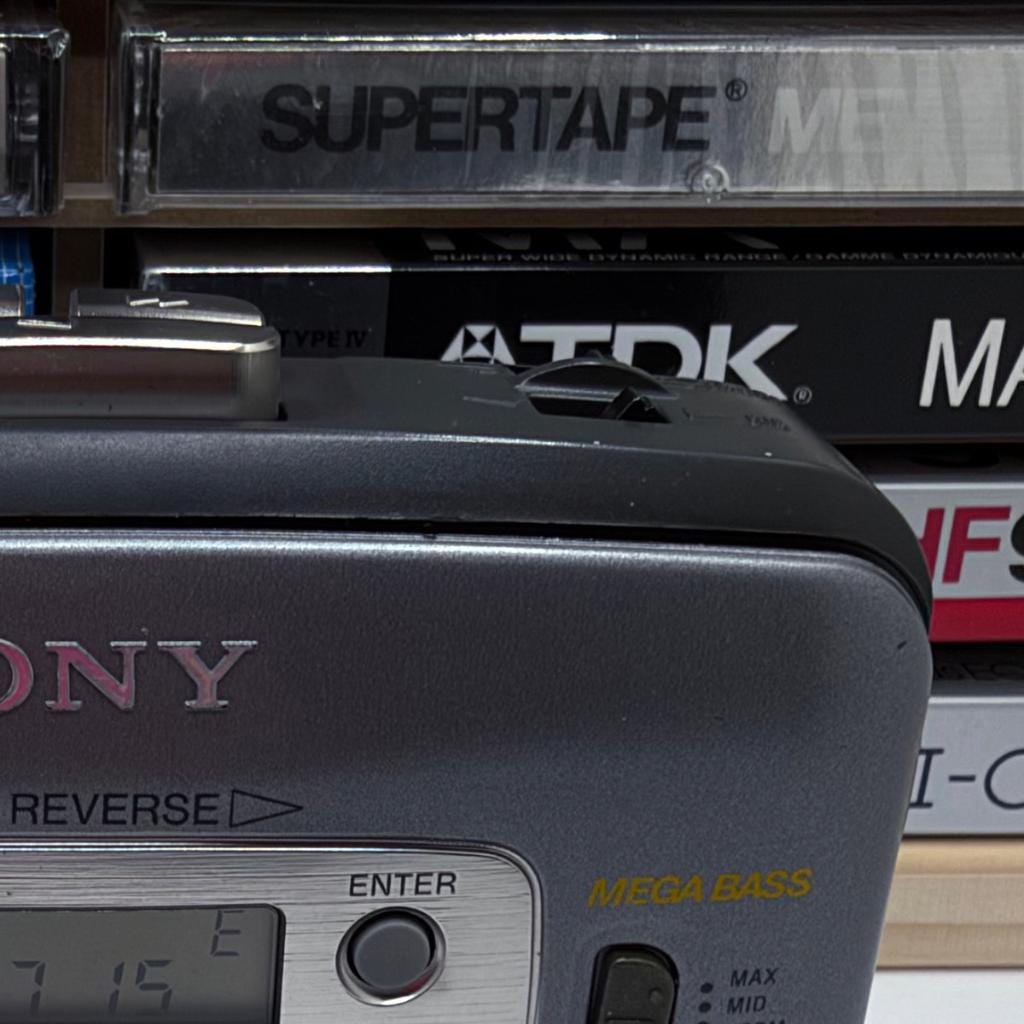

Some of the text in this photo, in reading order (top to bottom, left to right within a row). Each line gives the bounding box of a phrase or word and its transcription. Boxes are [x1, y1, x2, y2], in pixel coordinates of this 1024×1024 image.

[279, 329, 366, 348] TYPE IV
[11, 793, 220, 826] REVERSE
[349, 872, 457, 897] ENTER
[588, 868, 814, 908] MEGA BASS
[211, 909, 245, 957] E
[729, 967, 779, 987] MAX
[726, 996, 766, 1015] MID
